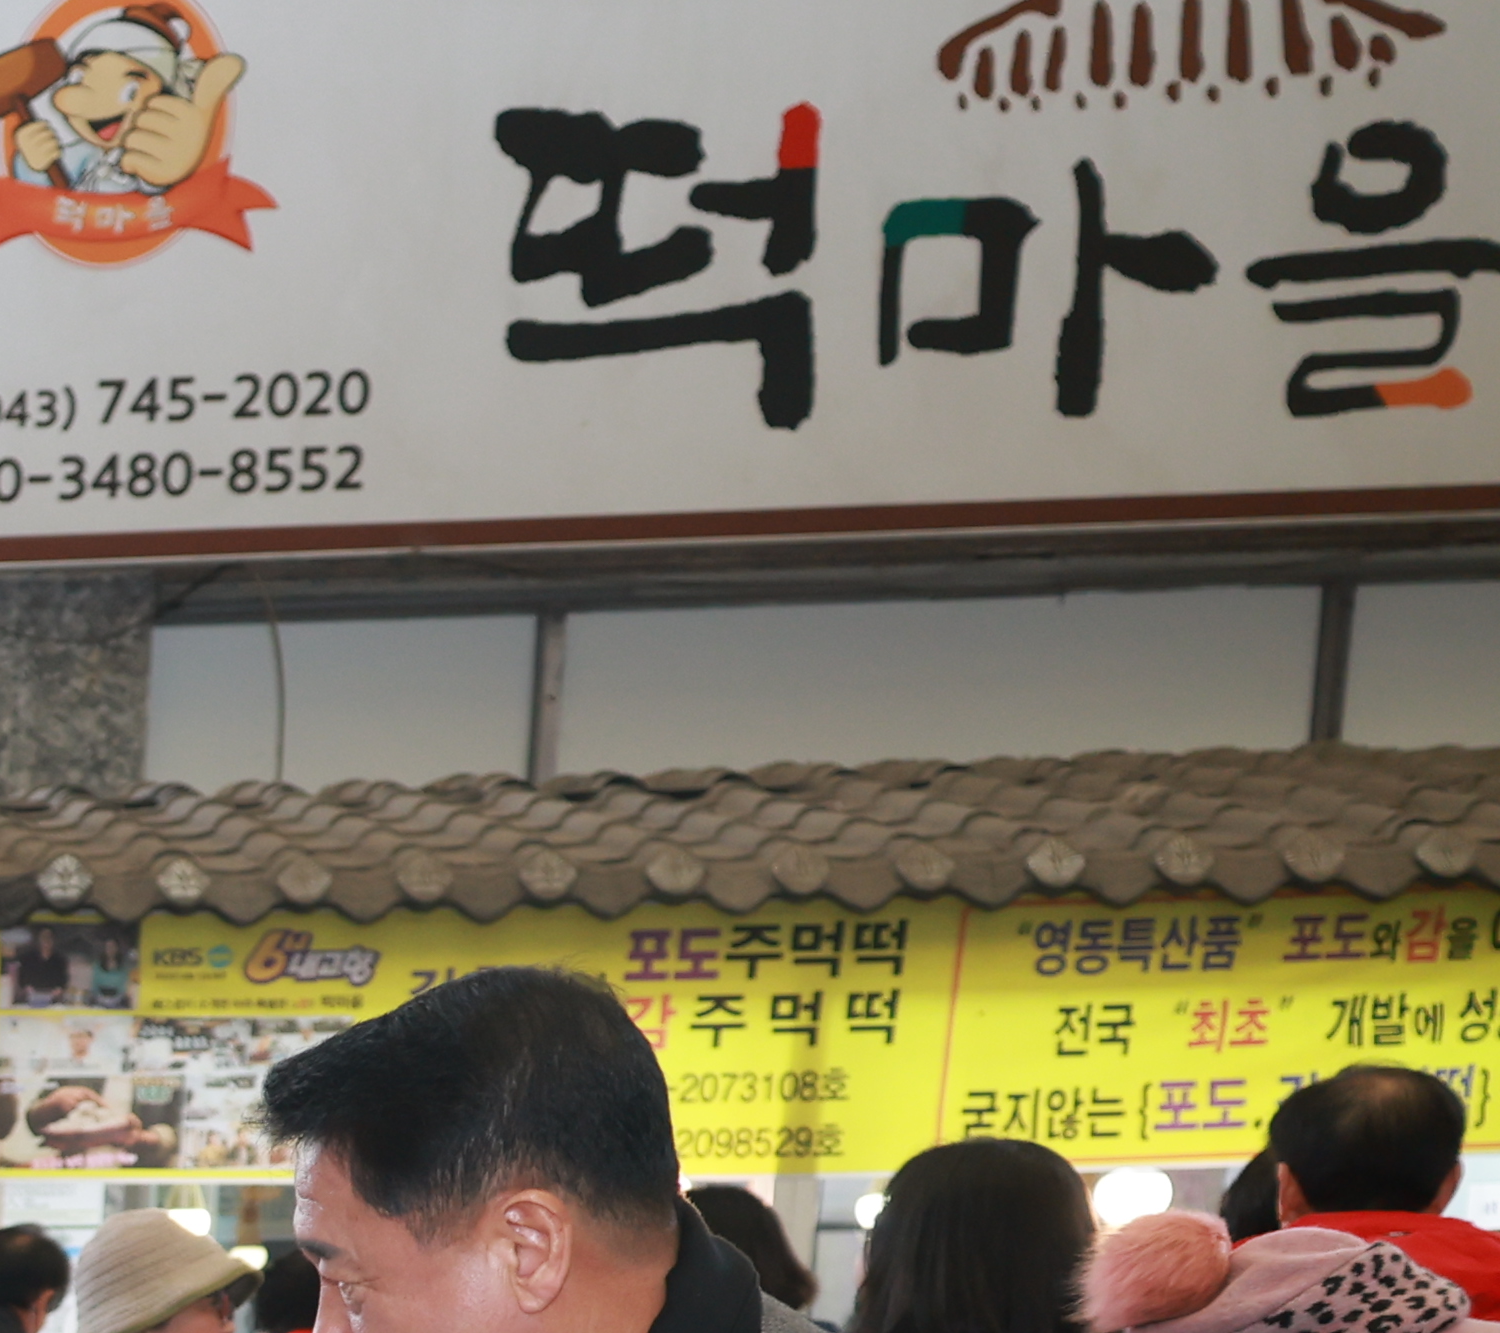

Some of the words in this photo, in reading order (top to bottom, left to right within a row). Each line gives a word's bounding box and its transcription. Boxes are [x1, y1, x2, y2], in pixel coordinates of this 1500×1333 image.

[494, 101, 1500, 429] 떡마을
[97, 370, 371, 425] 745-2020
[623, 919, 909, 982] 포도주먹떡
[1054, 1002, 1137, 1058] 전국
[1326, 992, 1445, 1046] 개발에
[1459, 987, 1500, 1044] 성
[669, 1066, 850, 1104] -2073108호
[961, 1085, 1128, 1143] 굳지않는
[678, 1123, 845, 1160] 2098529호
